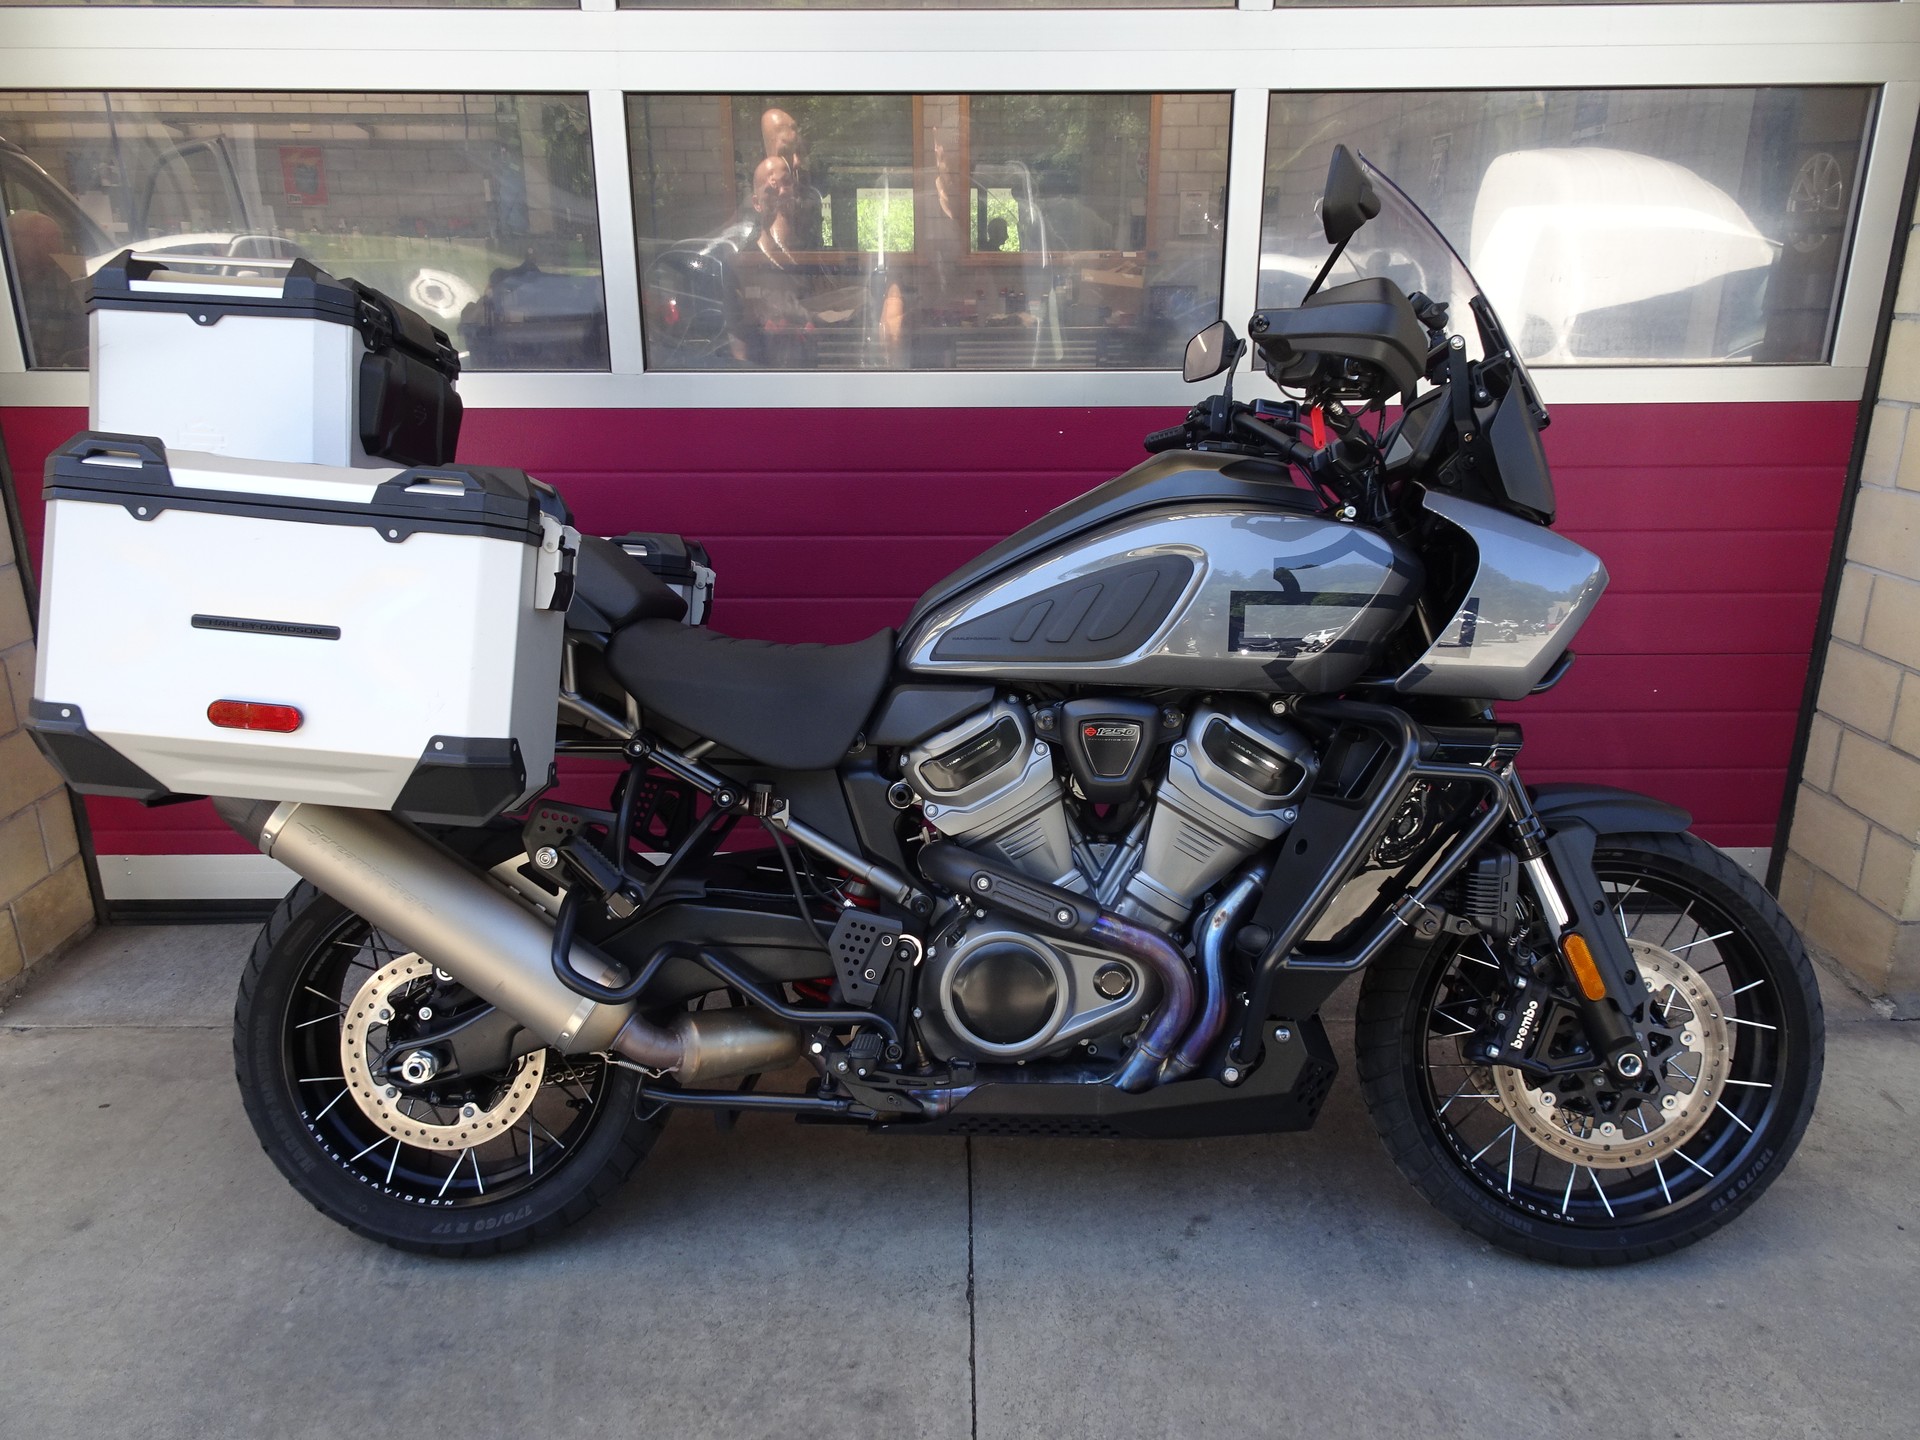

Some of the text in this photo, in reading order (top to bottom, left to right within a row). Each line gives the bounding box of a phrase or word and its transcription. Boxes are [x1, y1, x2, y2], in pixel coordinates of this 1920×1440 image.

[208, 619, 324, 635] HARLEY-DAVIDSON
[1096, 727, 1137, 737] 1250
[1510, 1000, 1539, 1050] brembo
[300, 1110, 454, 1206] HARLEY-DAVIDSON
[1436, 1108, 1575, 1223] HARLEY-DAVIDSON
[1737, 1147, 1774, 1190] 120/70
[455, 1221, 470, 1234] R
[474, 1204, 533, 1232] 170/60
